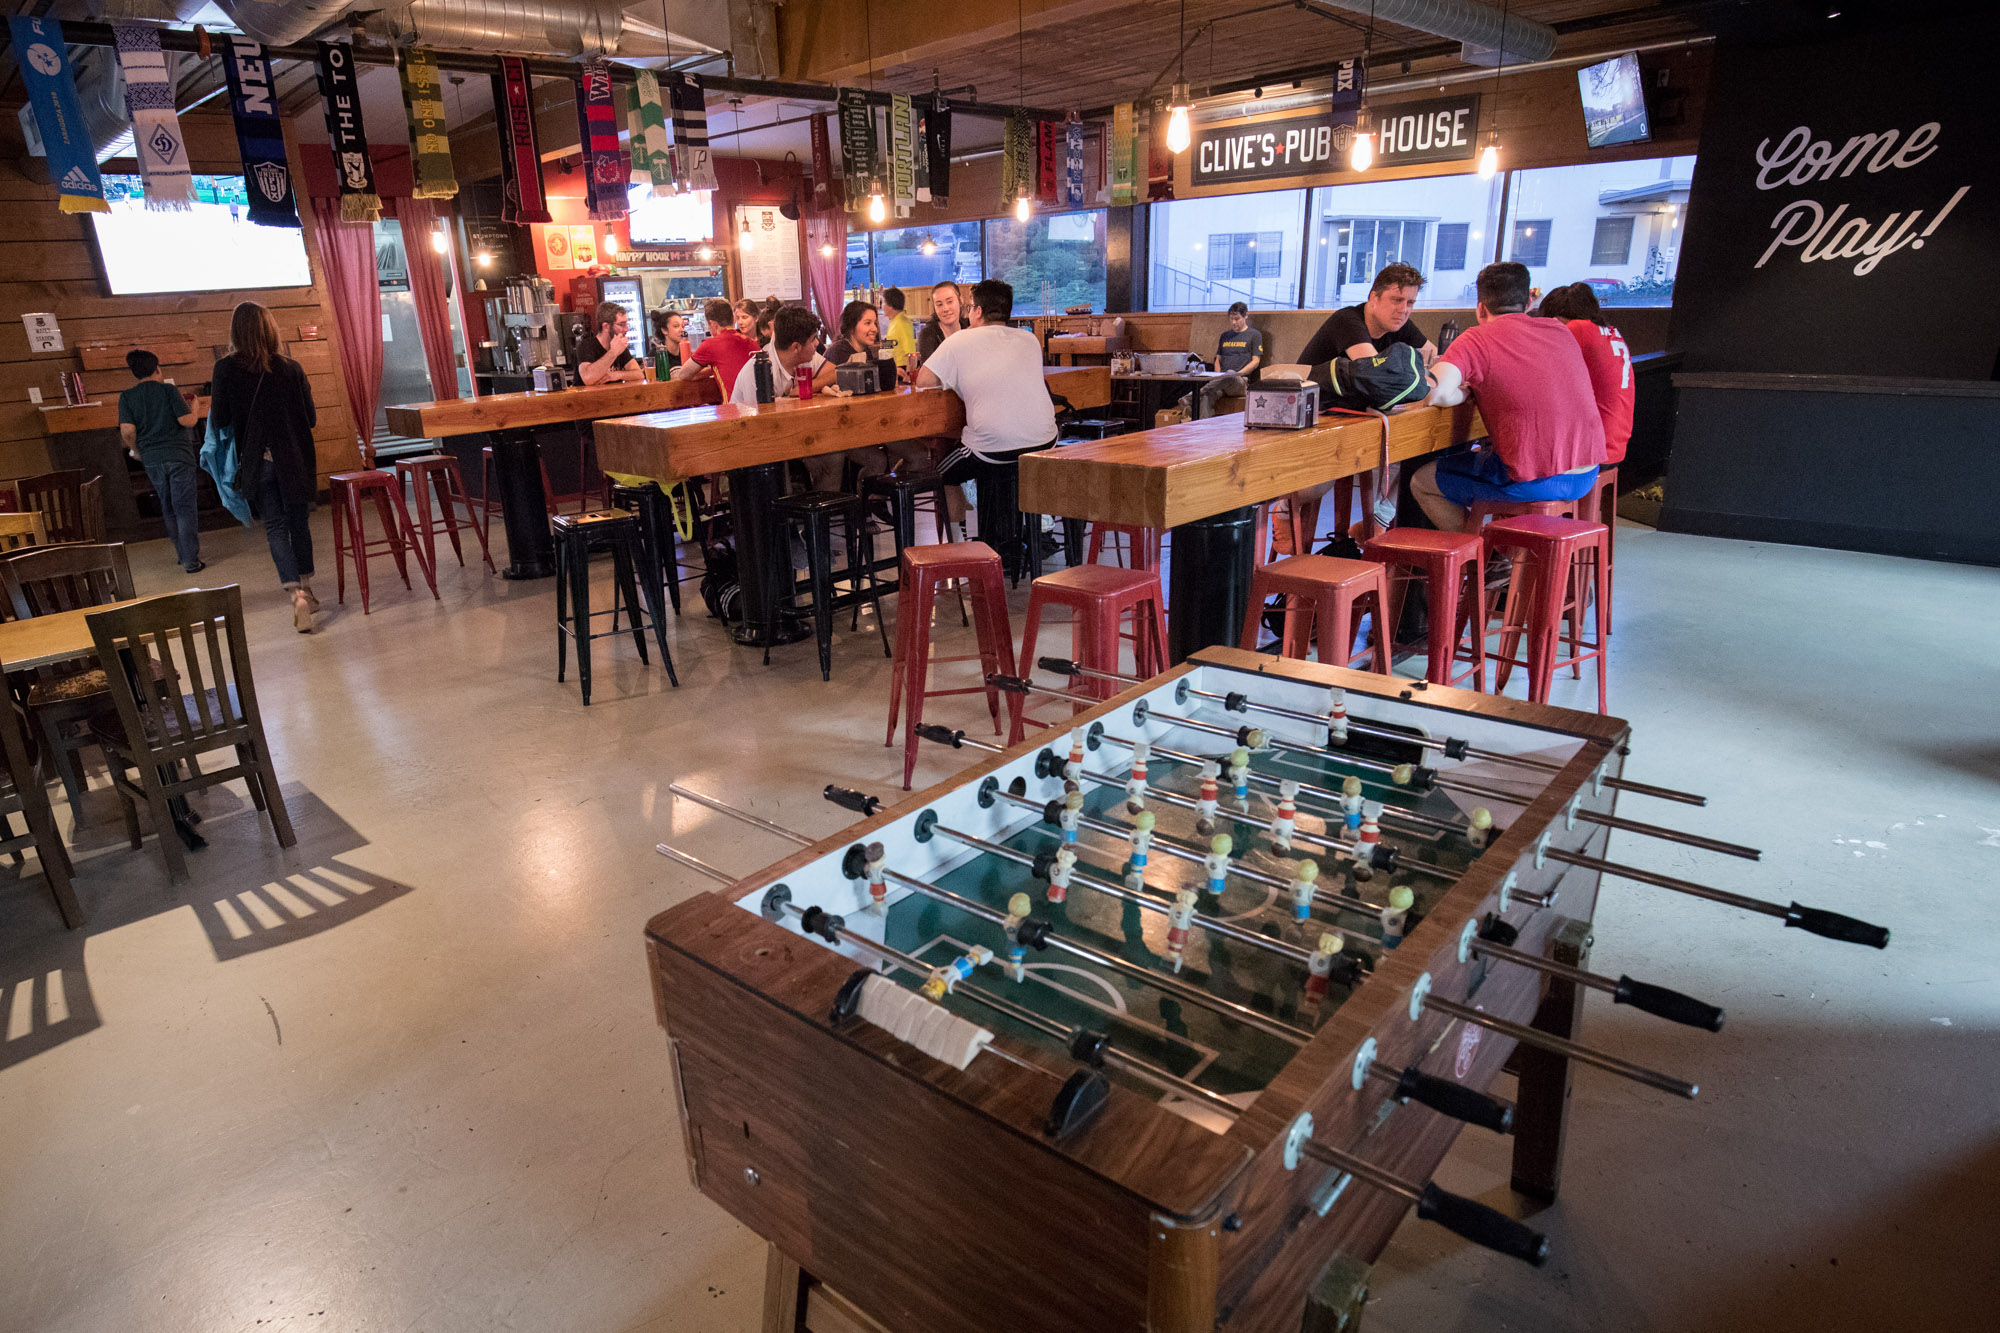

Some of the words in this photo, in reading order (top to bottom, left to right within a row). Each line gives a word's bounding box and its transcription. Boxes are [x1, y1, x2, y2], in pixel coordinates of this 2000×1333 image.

[327, 42, 347, 85] TO
[1337, 59, 1355, 92] PDX
[56, 107, 71, 145] ZARAGOZA
[336, 95, 356, 144] THE
[420, 98, 436, 128] ONE
[511, 97, 532, 146] ROSE
[425, 133, 439, 153] NO
[1200, 132, 1276, 173] CLIVE'S
[1284, 125, 1332, 164] PUB
[1380, 108, 1471, 154] HOUSE
[1755, 121, 1941, 191] Come
[61, 179, 98, 192] adidas
[258, 170, 284, 179] UNITED
[1754, 185, 1972, 276] Play!
[616, 251, 645, 262] HAPPY
[645, 251, 670, 262] HOUR
[1610, 340, 1631, 389] 7
